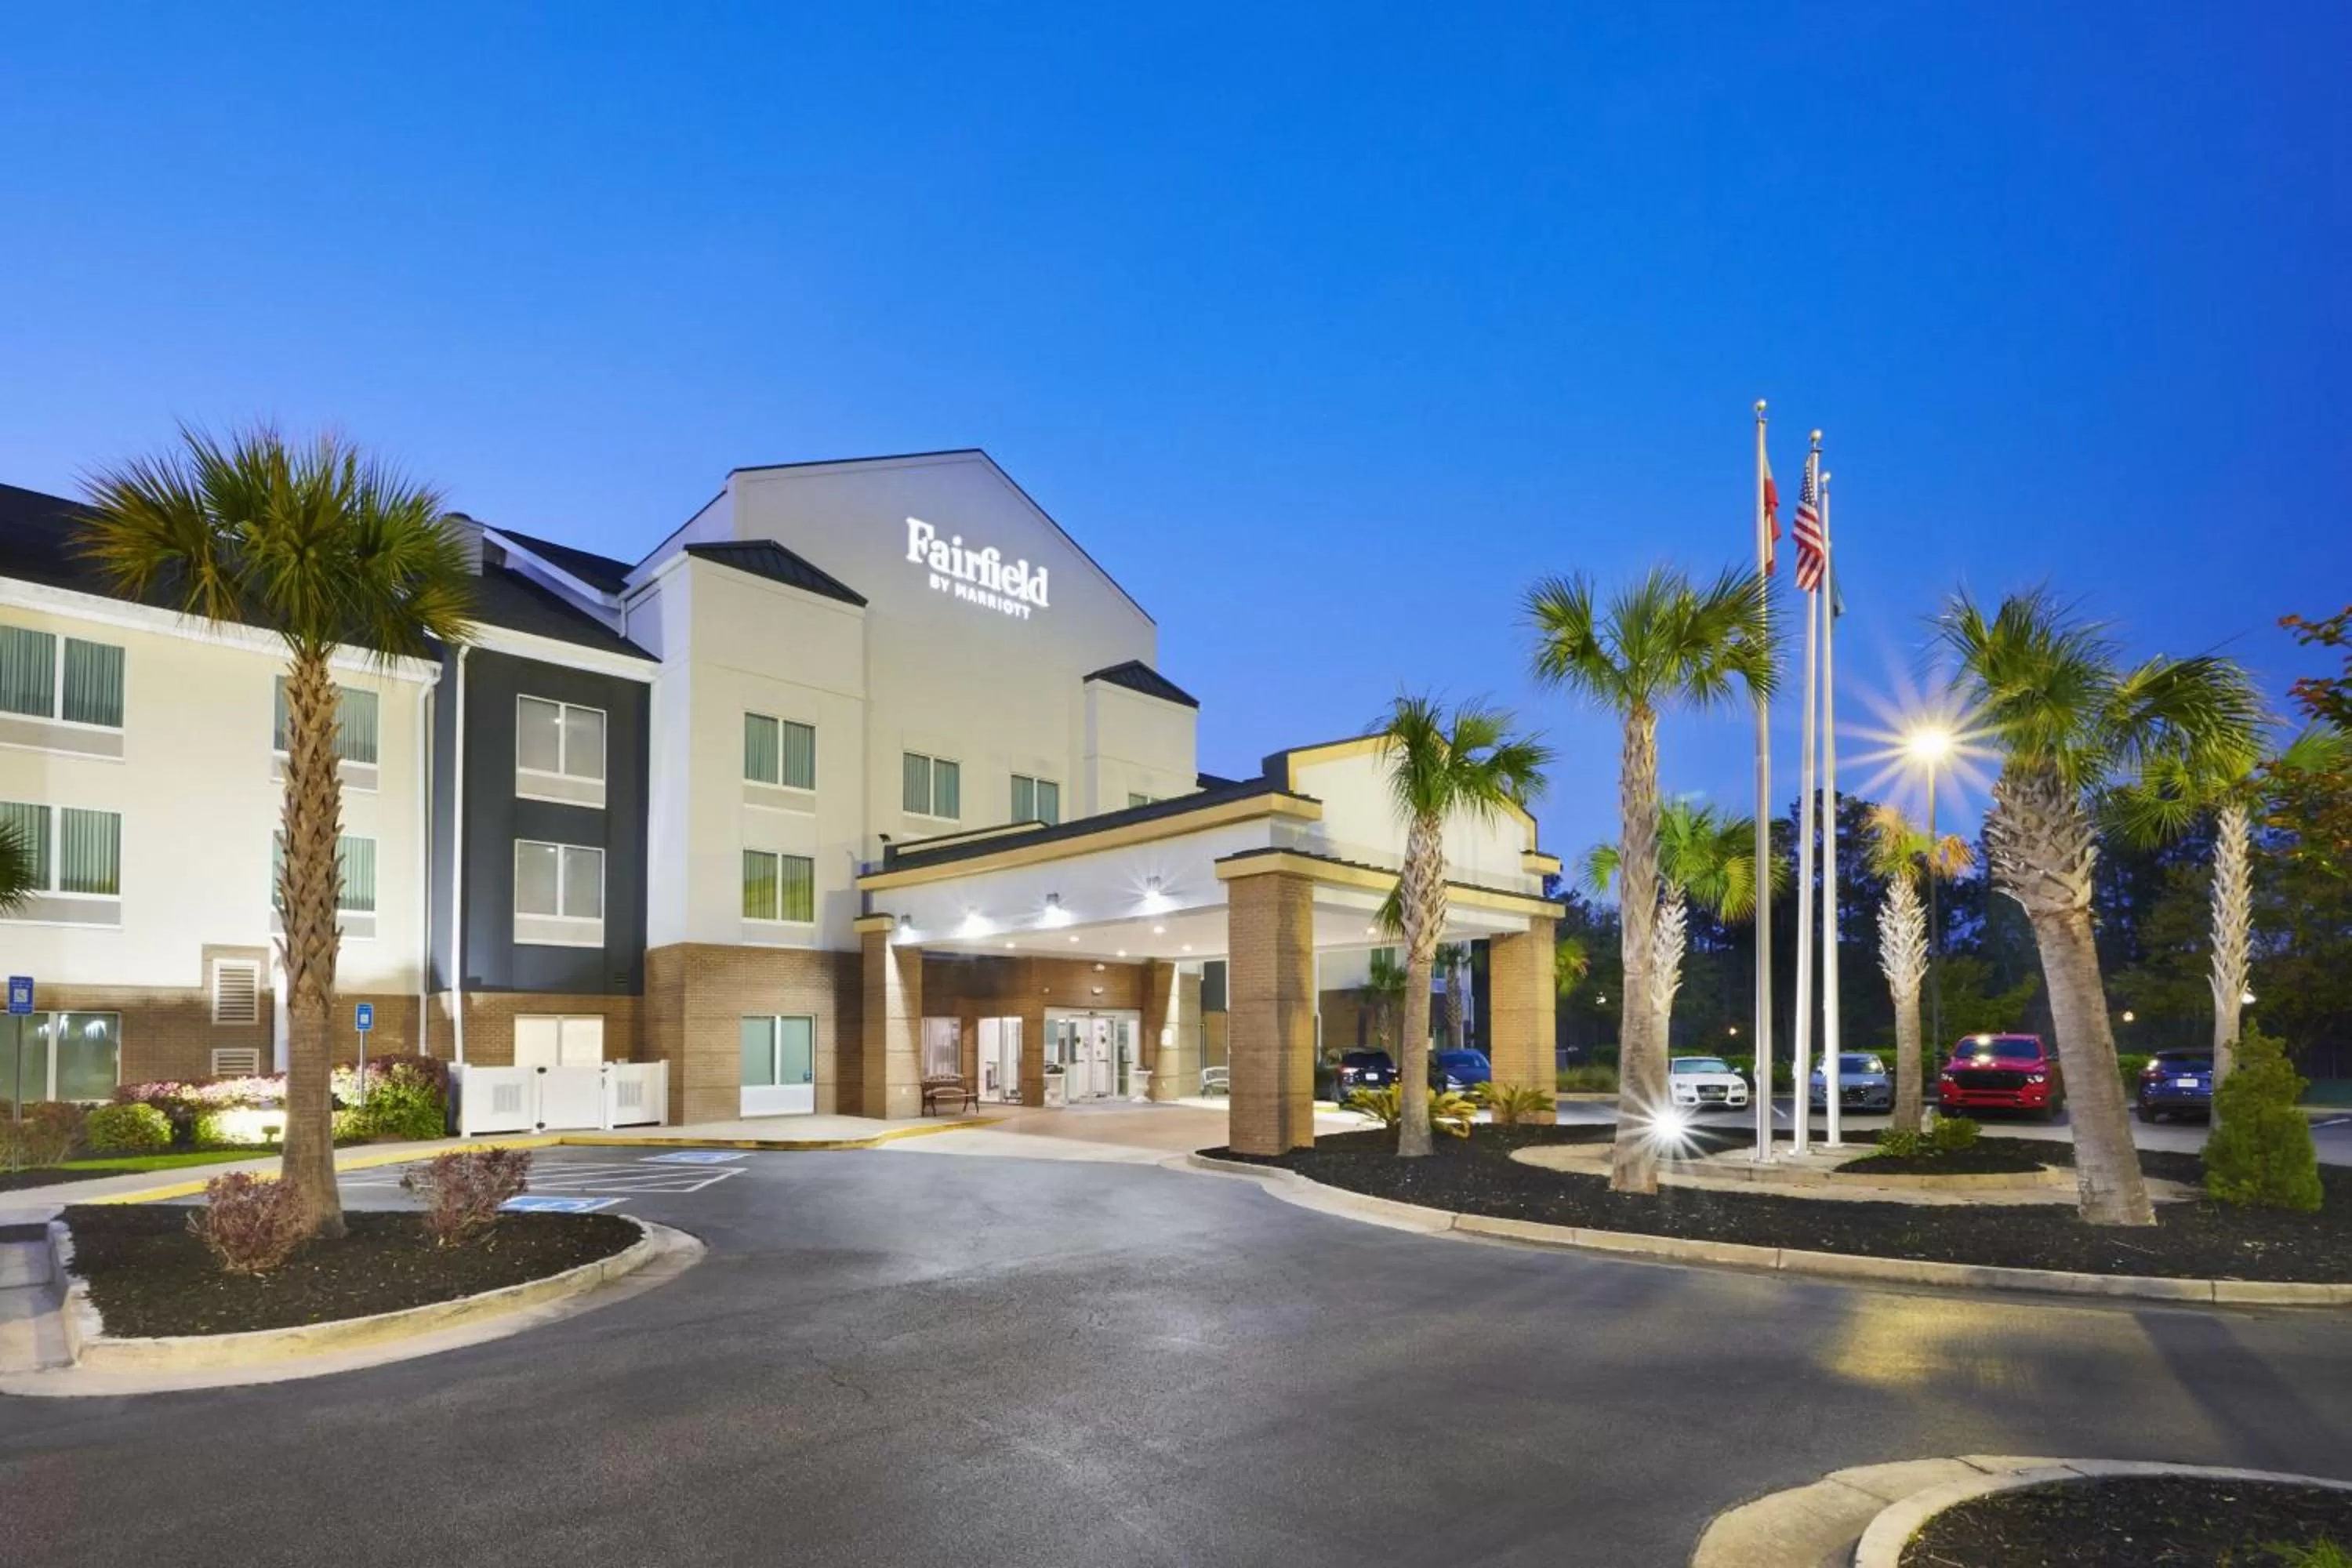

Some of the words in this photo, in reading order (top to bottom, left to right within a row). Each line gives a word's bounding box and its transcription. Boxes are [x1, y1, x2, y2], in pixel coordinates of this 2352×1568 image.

[906, 517, 1050, 608] Fairfield
[929, 573, 950, 593] BY
[955, 583, 1031, 620] MARRIOTT
